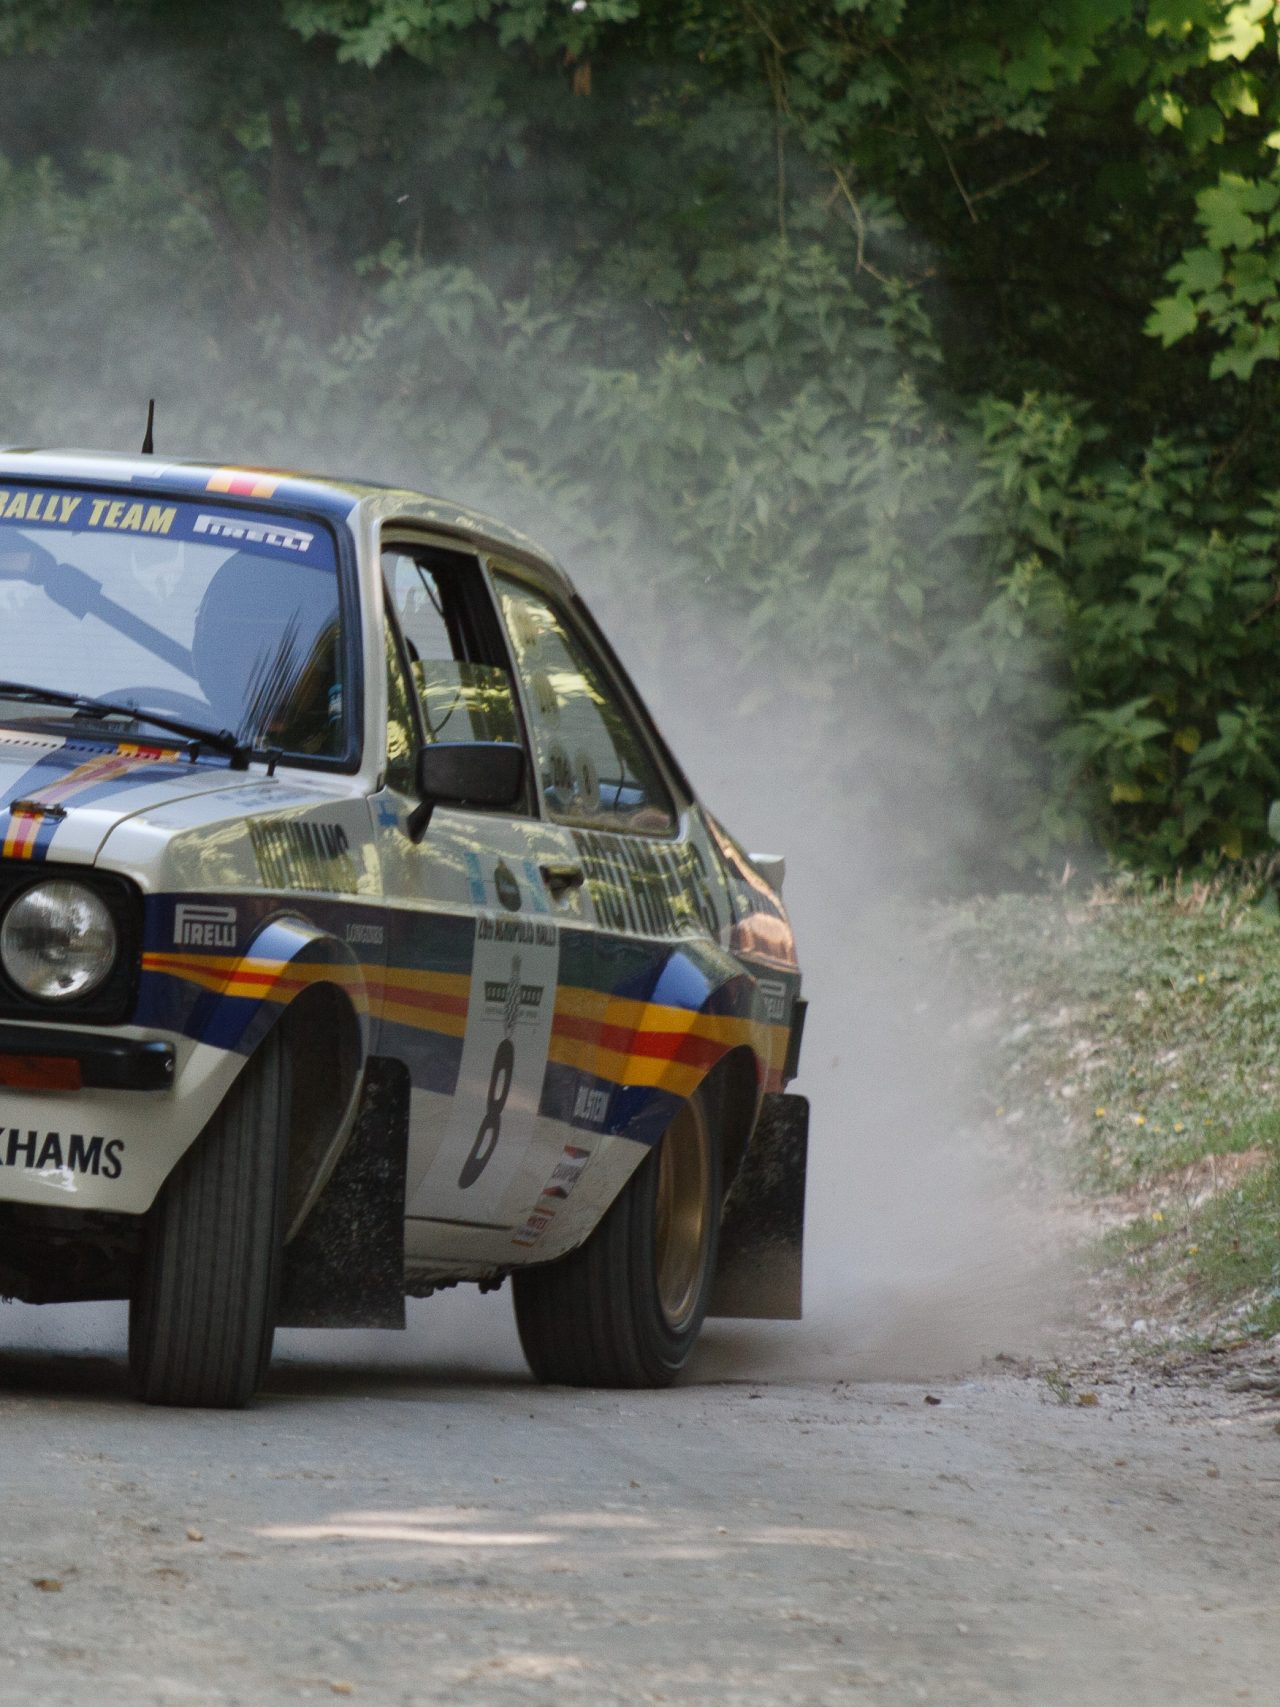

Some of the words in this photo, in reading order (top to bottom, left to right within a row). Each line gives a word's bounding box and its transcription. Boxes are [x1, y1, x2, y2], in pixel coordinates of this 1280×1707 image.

[88, 499, 177, 534] TEAM
[193, 514, 314, 552] PIRELLI
[173, 903, 237, 947] PIRELLI
[458, 1039, 514, 1190] 8
